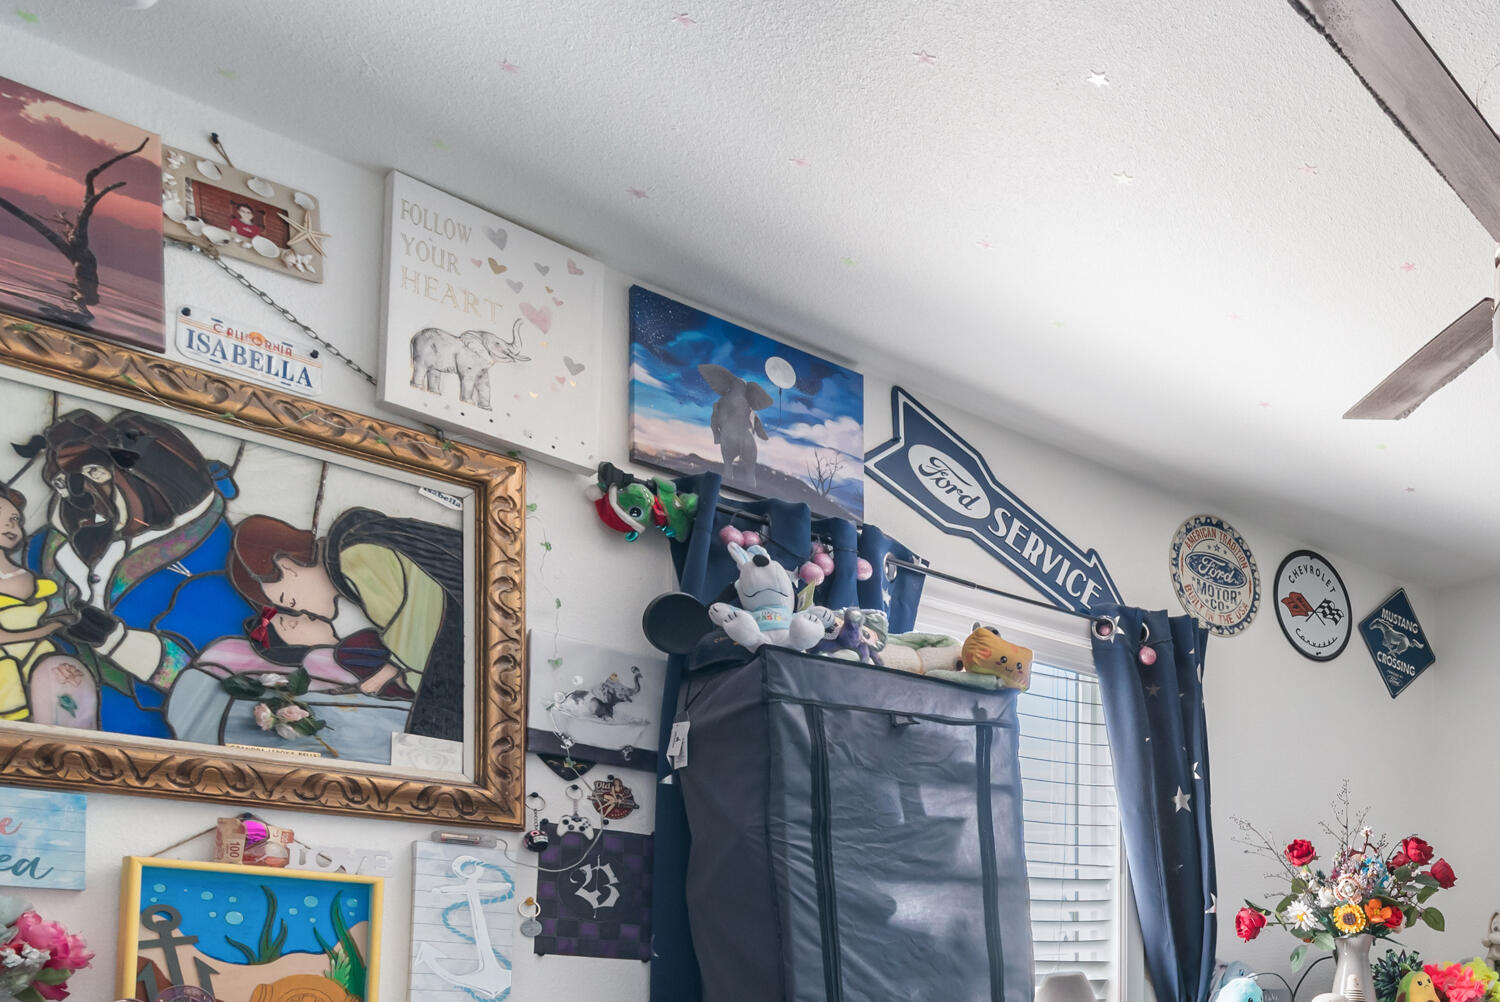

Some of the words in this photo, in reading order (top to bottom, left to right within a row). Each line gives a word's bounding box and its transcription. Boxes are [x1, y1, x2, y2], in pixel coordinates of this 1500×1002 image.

[401, 199, 471, 244] FOLLOW
[401, 231, 460, 275] YOUR
[401, 265, 504, 323] HEART
[186, 328, 313, 388] ISABELLA
[918, 456, 981, 511] Ford
[988, 507, 1102, 610] SERVICE
[1184, 527, 1217, 551] AMERICAN
[1219, 531, 1249, 569] TRADITION
[1198, 556, 1236, 582] Ford
[1197, 579, 1237, 605] MOTOR
[1288, 564, 1336, 594] CHEVROLET
[1184, 583, 1205, 610] BUILT
[1205, 608, 1216, 622] IN
[1218, 614, 1235, 625] THE
[1236, 602, 1250, 619] USA
[1381, 608, 1419, 634] MUSTANG
[1376, 651, 1416, 677] CROSSING
[229, 841, 241, 858] 100
